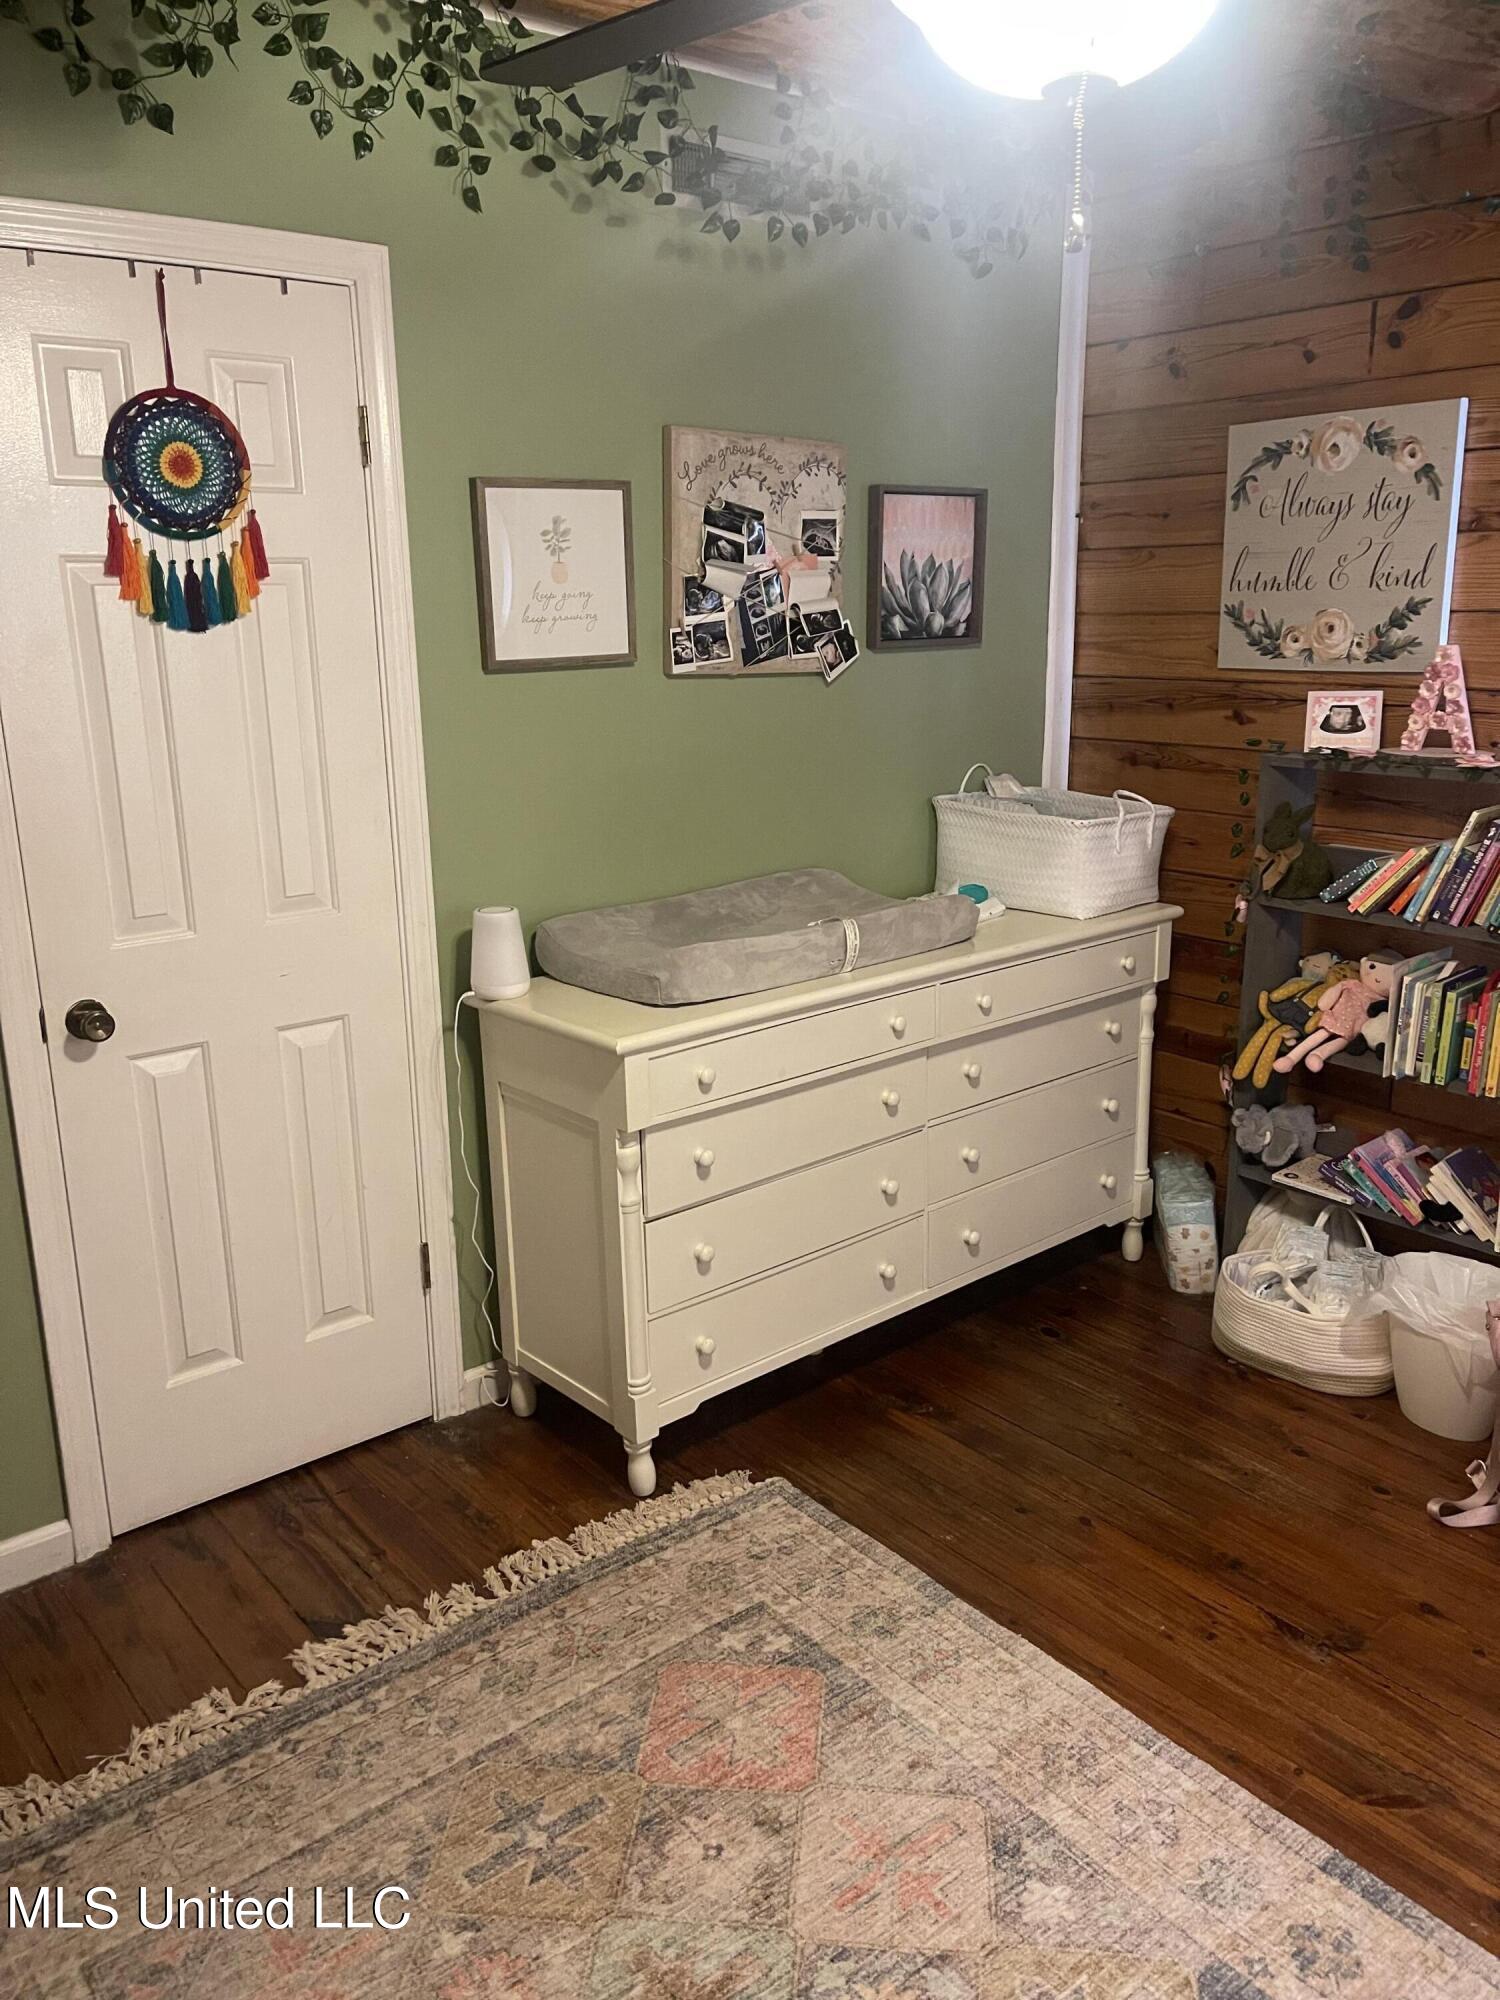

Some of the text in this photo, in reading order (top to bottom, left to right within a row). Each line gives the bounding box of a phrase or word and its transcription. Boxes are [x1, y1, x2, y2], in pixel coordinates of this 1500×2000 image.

[678, 442, 786, 491] Love grows here
[1259, 471, 1416, 543] Always stay
[1229, 536, 1438, 594] humble & kind
[521, 604, 599, 635] keep growing
[532, 580, 594, 612] keep going
